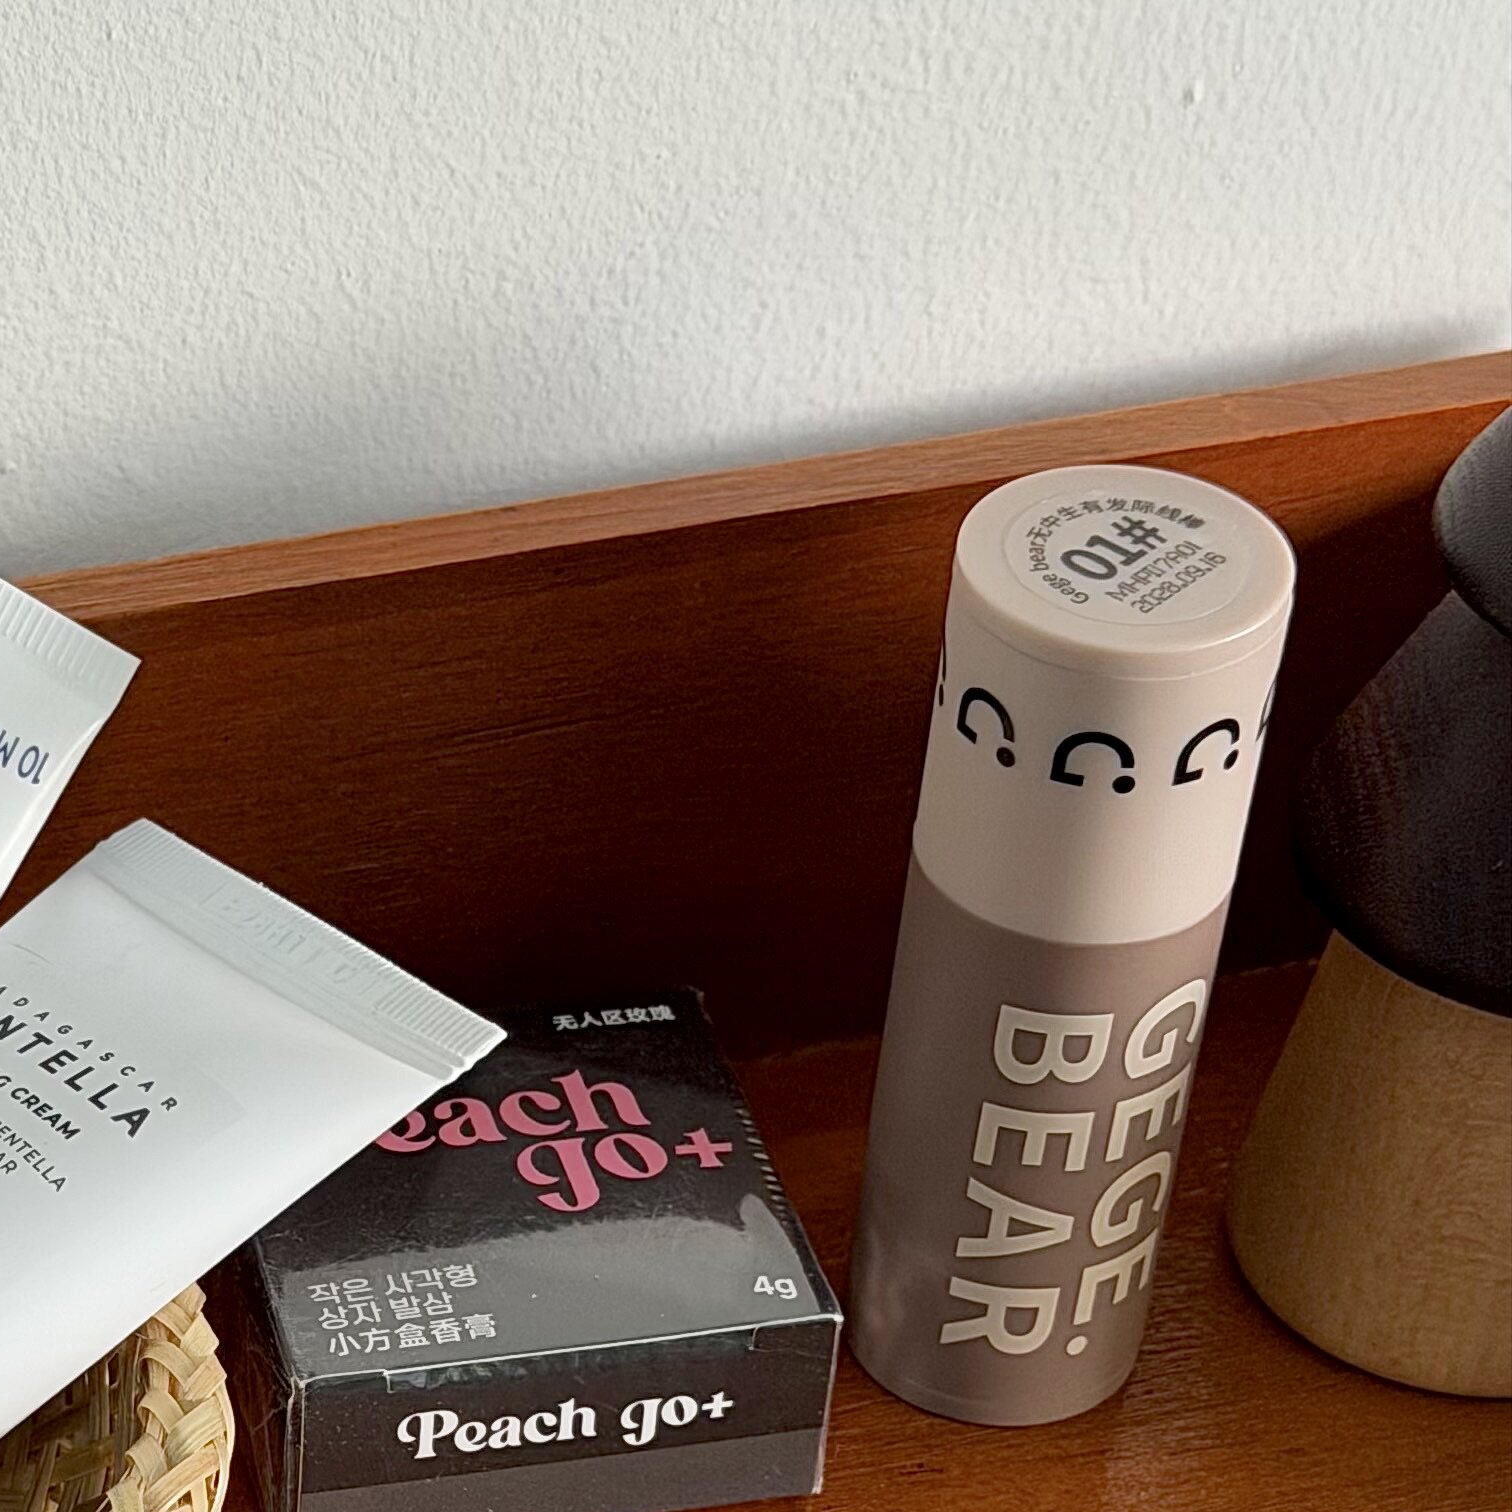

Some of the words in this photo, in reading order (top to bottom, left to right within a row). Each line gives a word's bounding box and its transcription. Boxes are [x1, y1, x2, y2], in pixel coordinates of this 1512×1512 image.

[1060, 515, 1168, 581] 01#
[18, 745, 50, 784] 10
[552, 1004, 676, 1031] 无人区玫瑰
[9, 1086, 81, 1141] CREAM
[373, 1068, 652, 1153] each
[516, 1127, 733, 1212] go+
[939, 1004, 1115, 1355] BEAR
[307, 1278, 374, 1304] 작은
[385, 1263, 478, 1295] 사각형
[752, 1274, 798, 1300] 4g
[318, 1301, 382, 1330] 상자
[388, 1291, 454, 1321] 발삼
[329, 1313, 497, 1356] 小方盒香膏
[397, 1397, 597, 1460] Peach
[620, 1390, 734, 1445] go+
